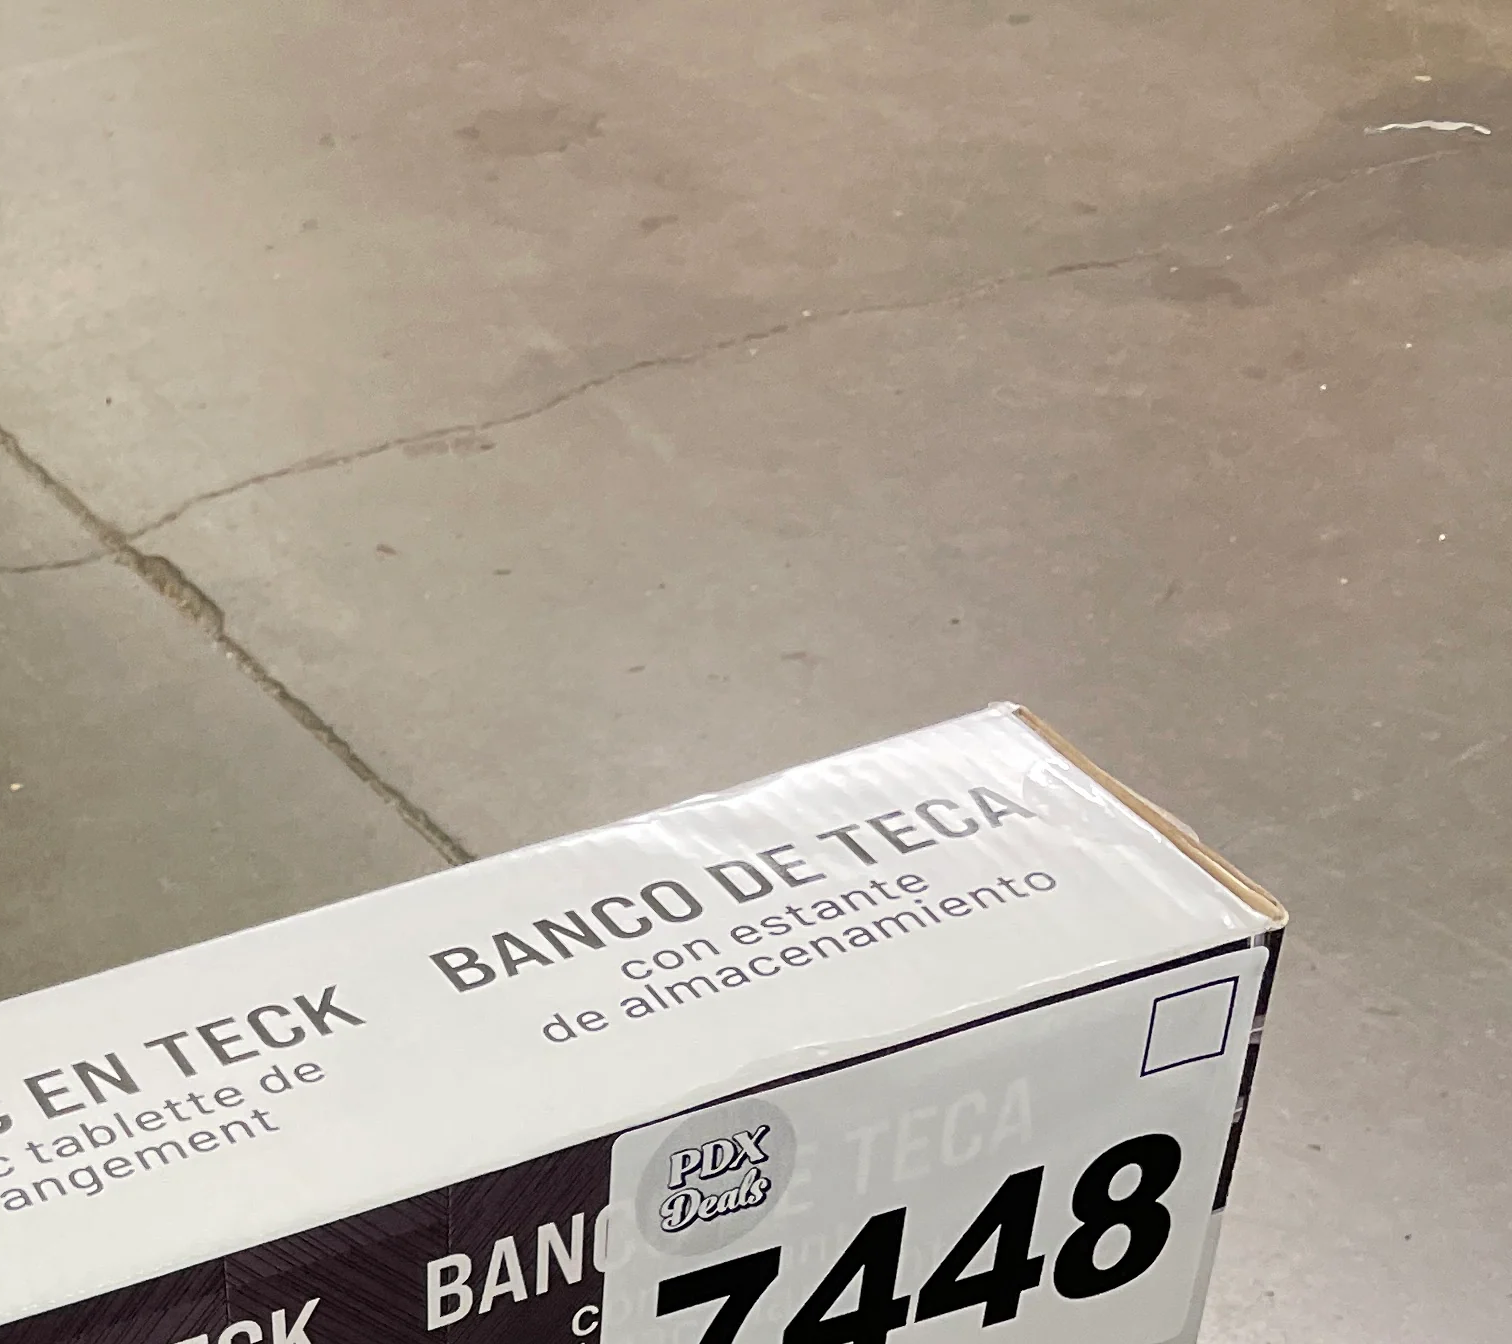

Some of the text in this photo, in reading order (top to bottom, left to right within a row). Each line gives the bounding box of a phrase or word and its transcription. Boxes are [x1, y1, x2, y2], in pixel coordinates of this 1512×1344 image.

[428, 785, 1037, 993] BANCO DE TECA
[620, 870, 930, 981] con estante
[542, 868, 1058, 1043] de almacenamiento
[23, 1052, 142, 1120] EN
[144, 985, 367, 1078] TECK
[24, 1085, 244, 1164] tablette
[259, 1059, 326, 1094] de
[668, 1125, 771, 1190] PDX
[658, 1168, 771, 1234] Deals
